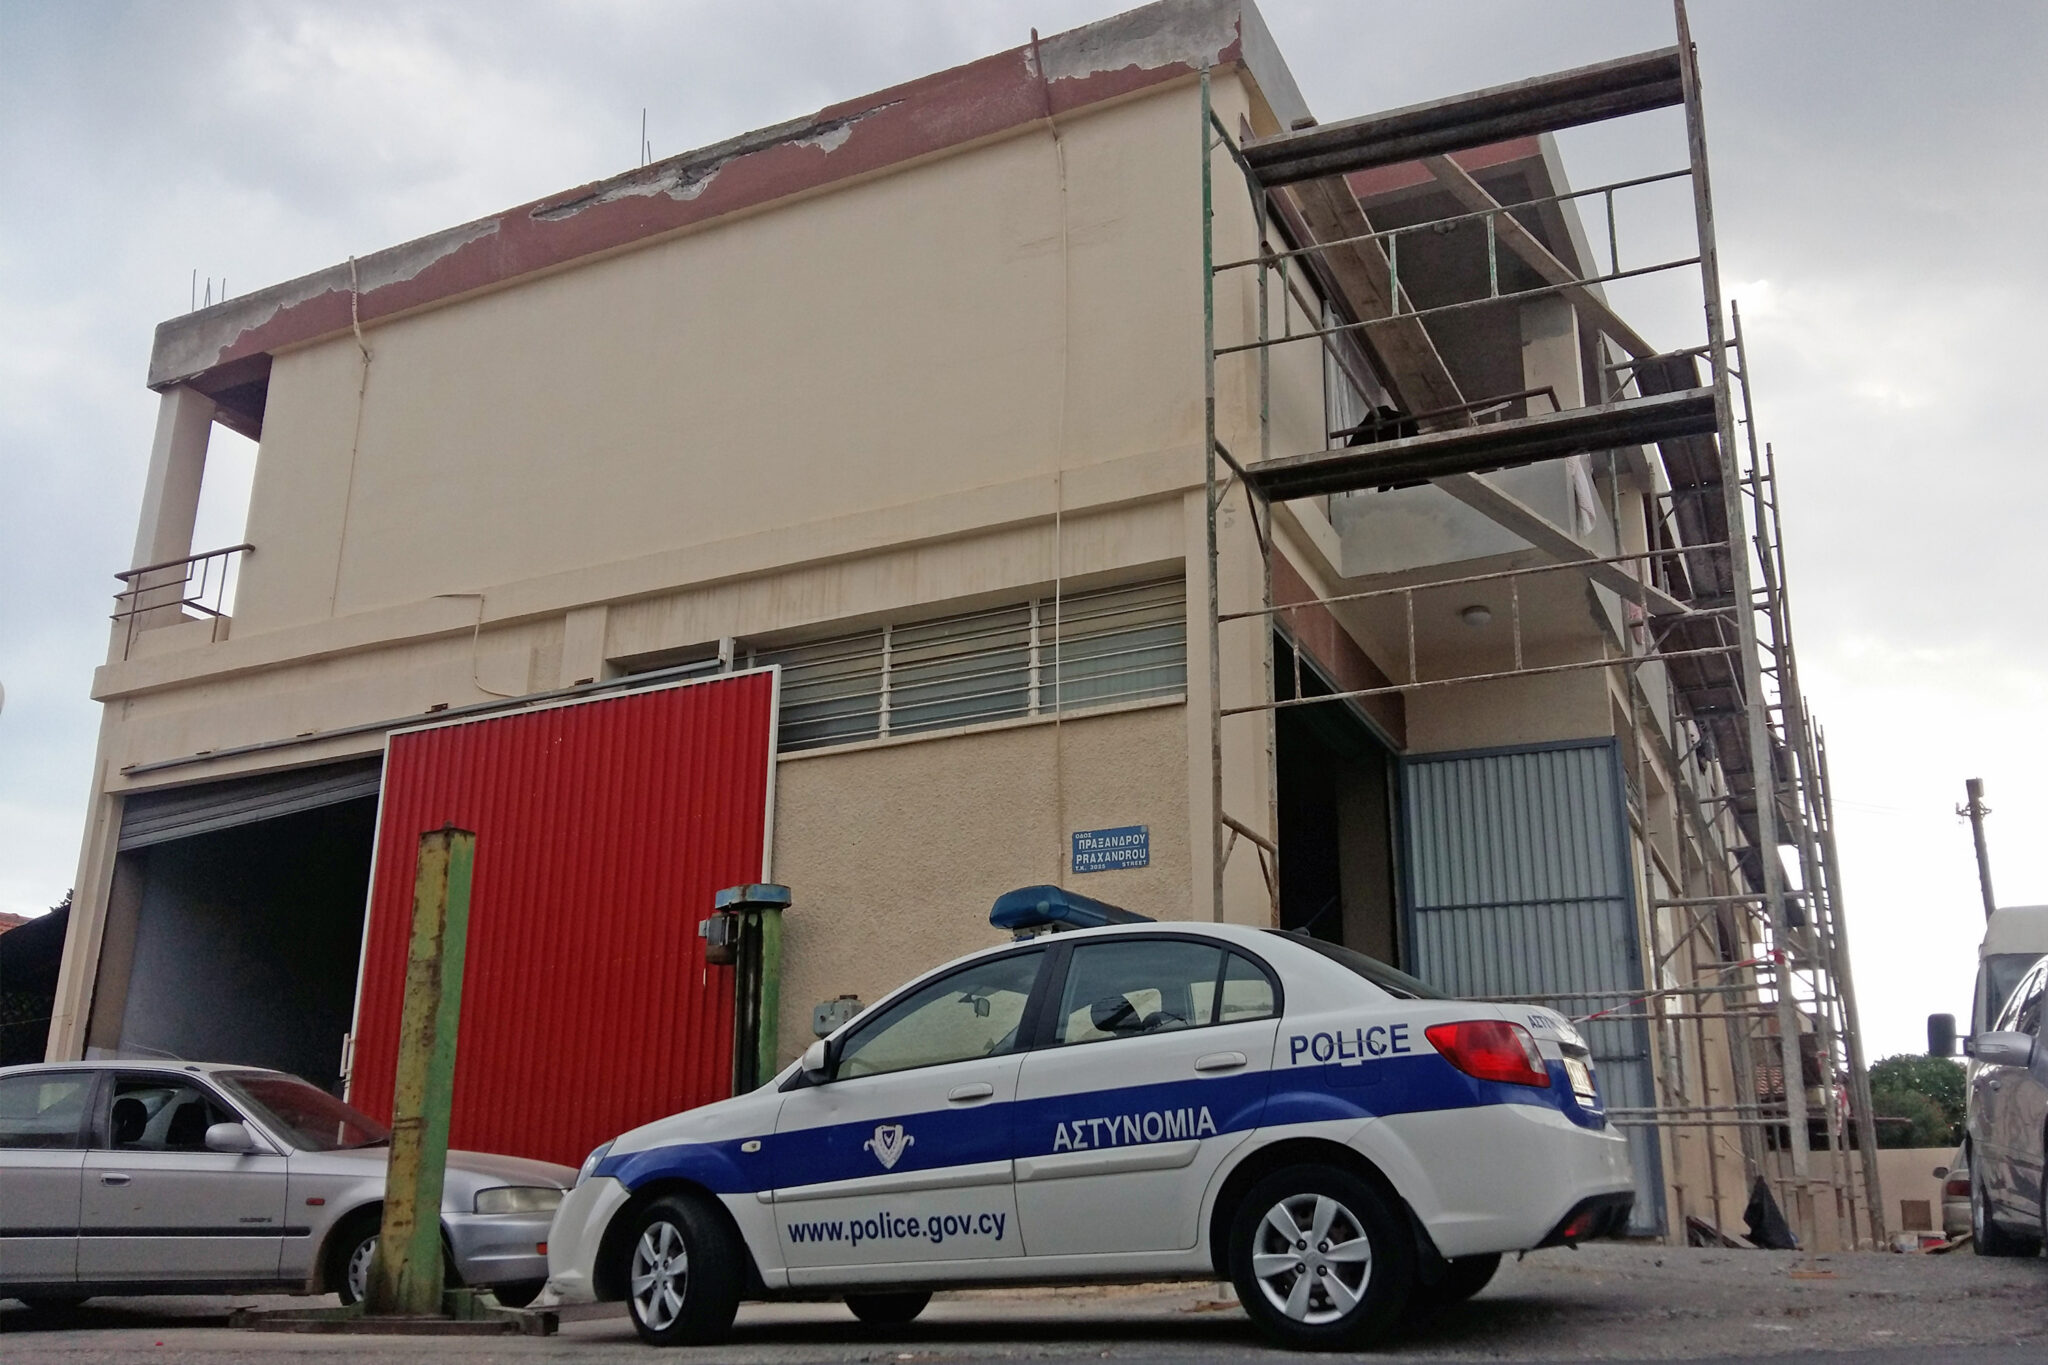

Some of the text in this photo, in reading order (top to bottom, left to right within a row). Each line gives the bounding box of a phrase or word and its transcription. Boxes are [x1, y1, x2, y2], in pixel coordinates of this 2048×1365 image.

[1076, 848, 1146, 865] PRAXANDROU
[1078, 834, 1146, 850] ΠΡΑΞΑΝΔΡΟΥ
[1290, 1023, 1412, 1065] POLICE
[1052, 1106, 1217, 1152] ΑΣΤΥΝΟΜΙΑ
[788, 1210, 1006, 1247] www.police.gov.cy
